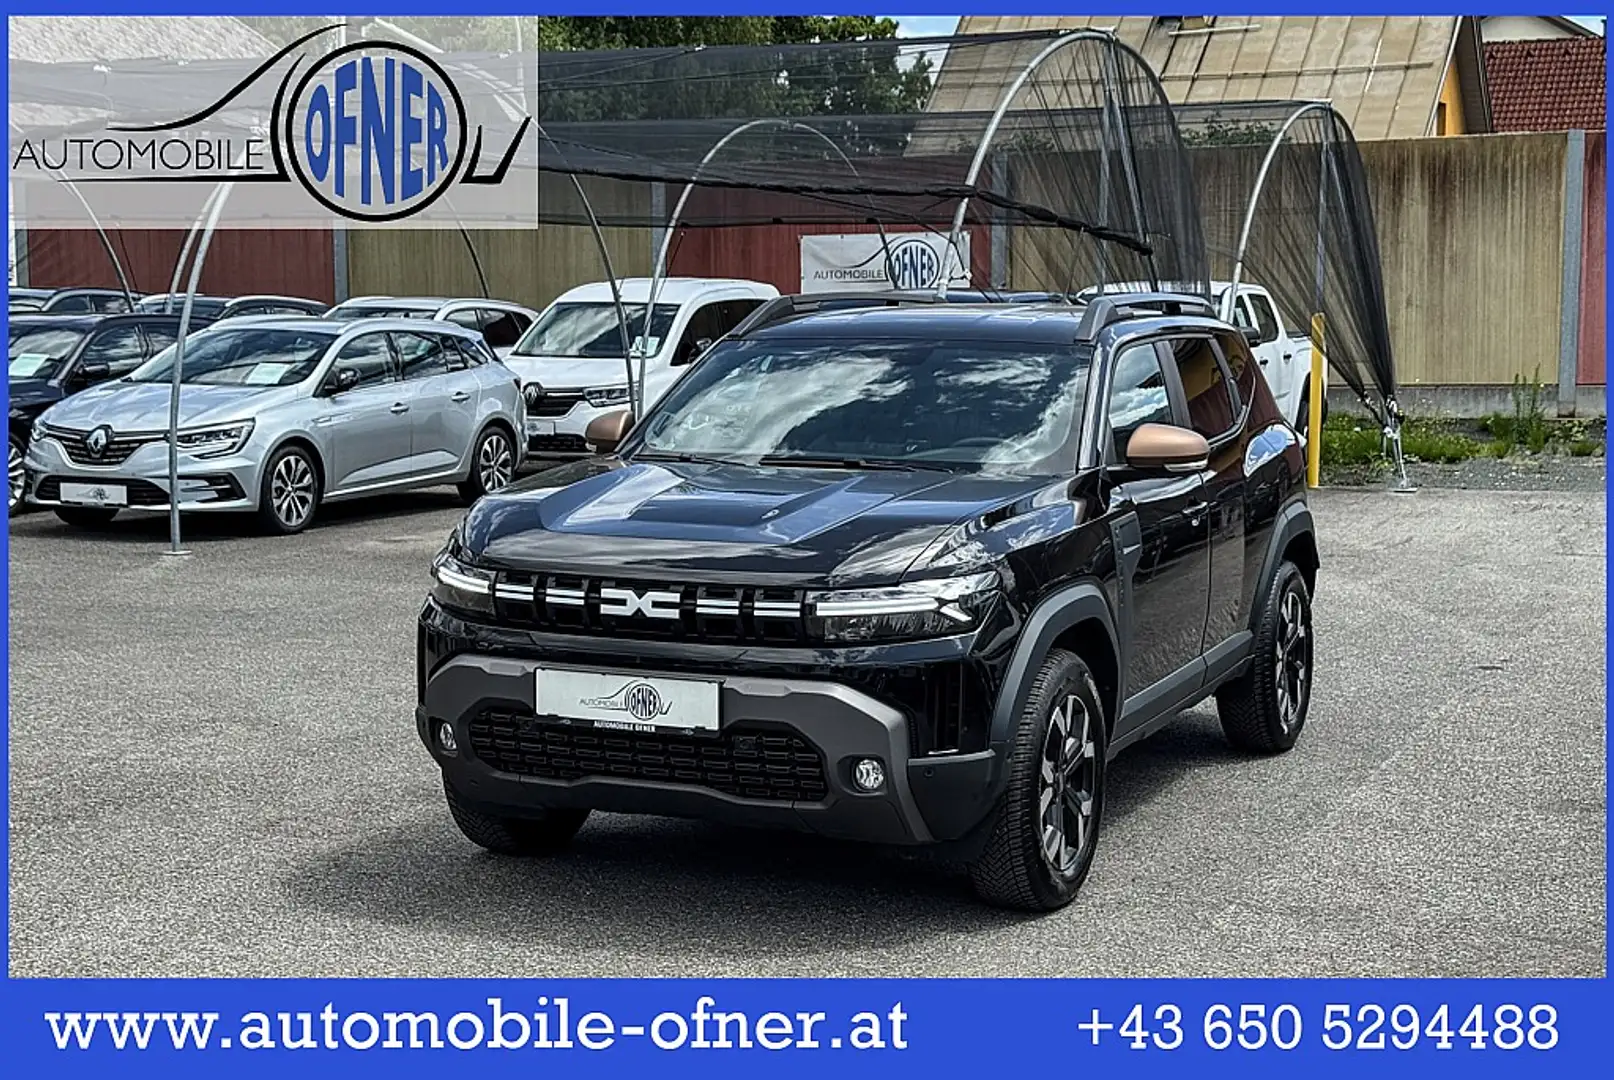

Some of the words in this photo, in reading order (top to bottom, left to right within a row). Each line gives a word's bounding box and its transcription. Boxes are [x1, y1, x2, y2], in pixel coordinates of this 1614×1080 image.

[813, 269, 884, 280] AUTOMOBILE
[892, 245, 935, 289] OFNER
[630, 687, 657, 717] OFNER
